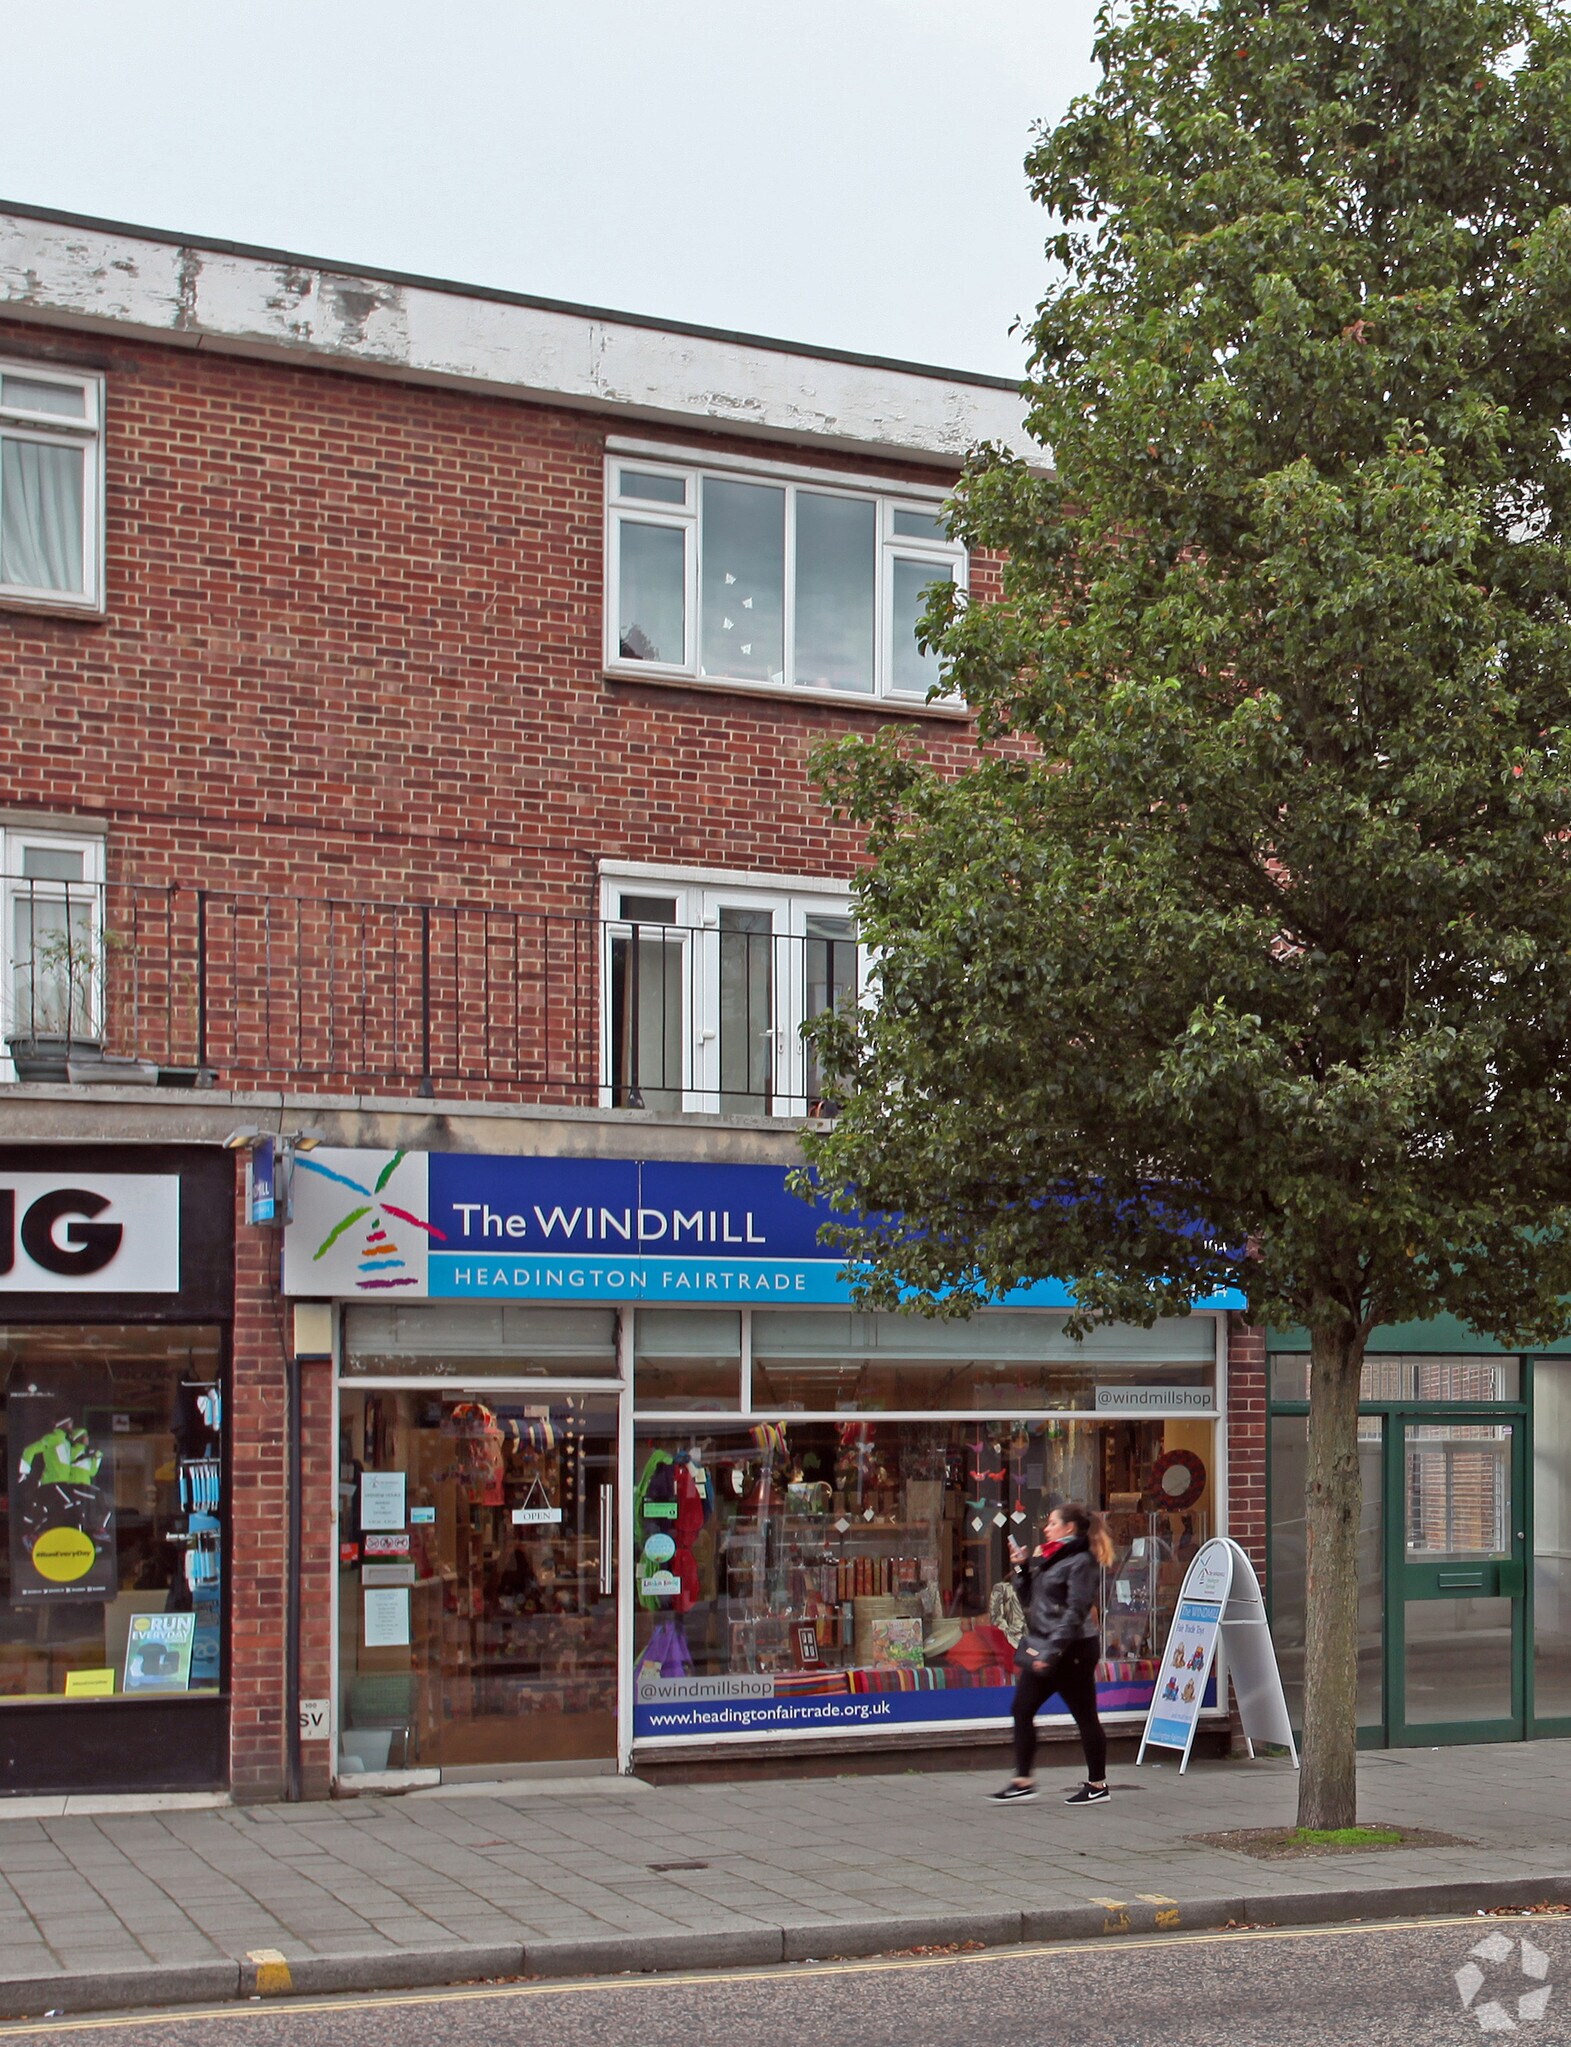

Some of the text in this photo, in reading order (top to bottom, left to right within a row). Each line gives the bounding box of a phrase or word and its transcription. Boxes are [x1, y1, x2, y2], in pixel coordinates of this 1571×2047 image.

[453, 1204, 766, 1243] The WINDMILL
[455, 1268, 806, 1291] HEADINGTON FAIRTRADE
[1098, 1390, 1211, 1407] @windmillshop
[523, 1512, 551, 1521] OPEN
[151, 1616, 192, 1631] RUN
[132, 1630, 190, 1641] EVERYDAY
[640, 1681, 772, 1698] @windmillshop
[300, 1712, 323, 1727] SV
[649, 1700, 891, 1726] www.headingtonfairtrade.org.uk
